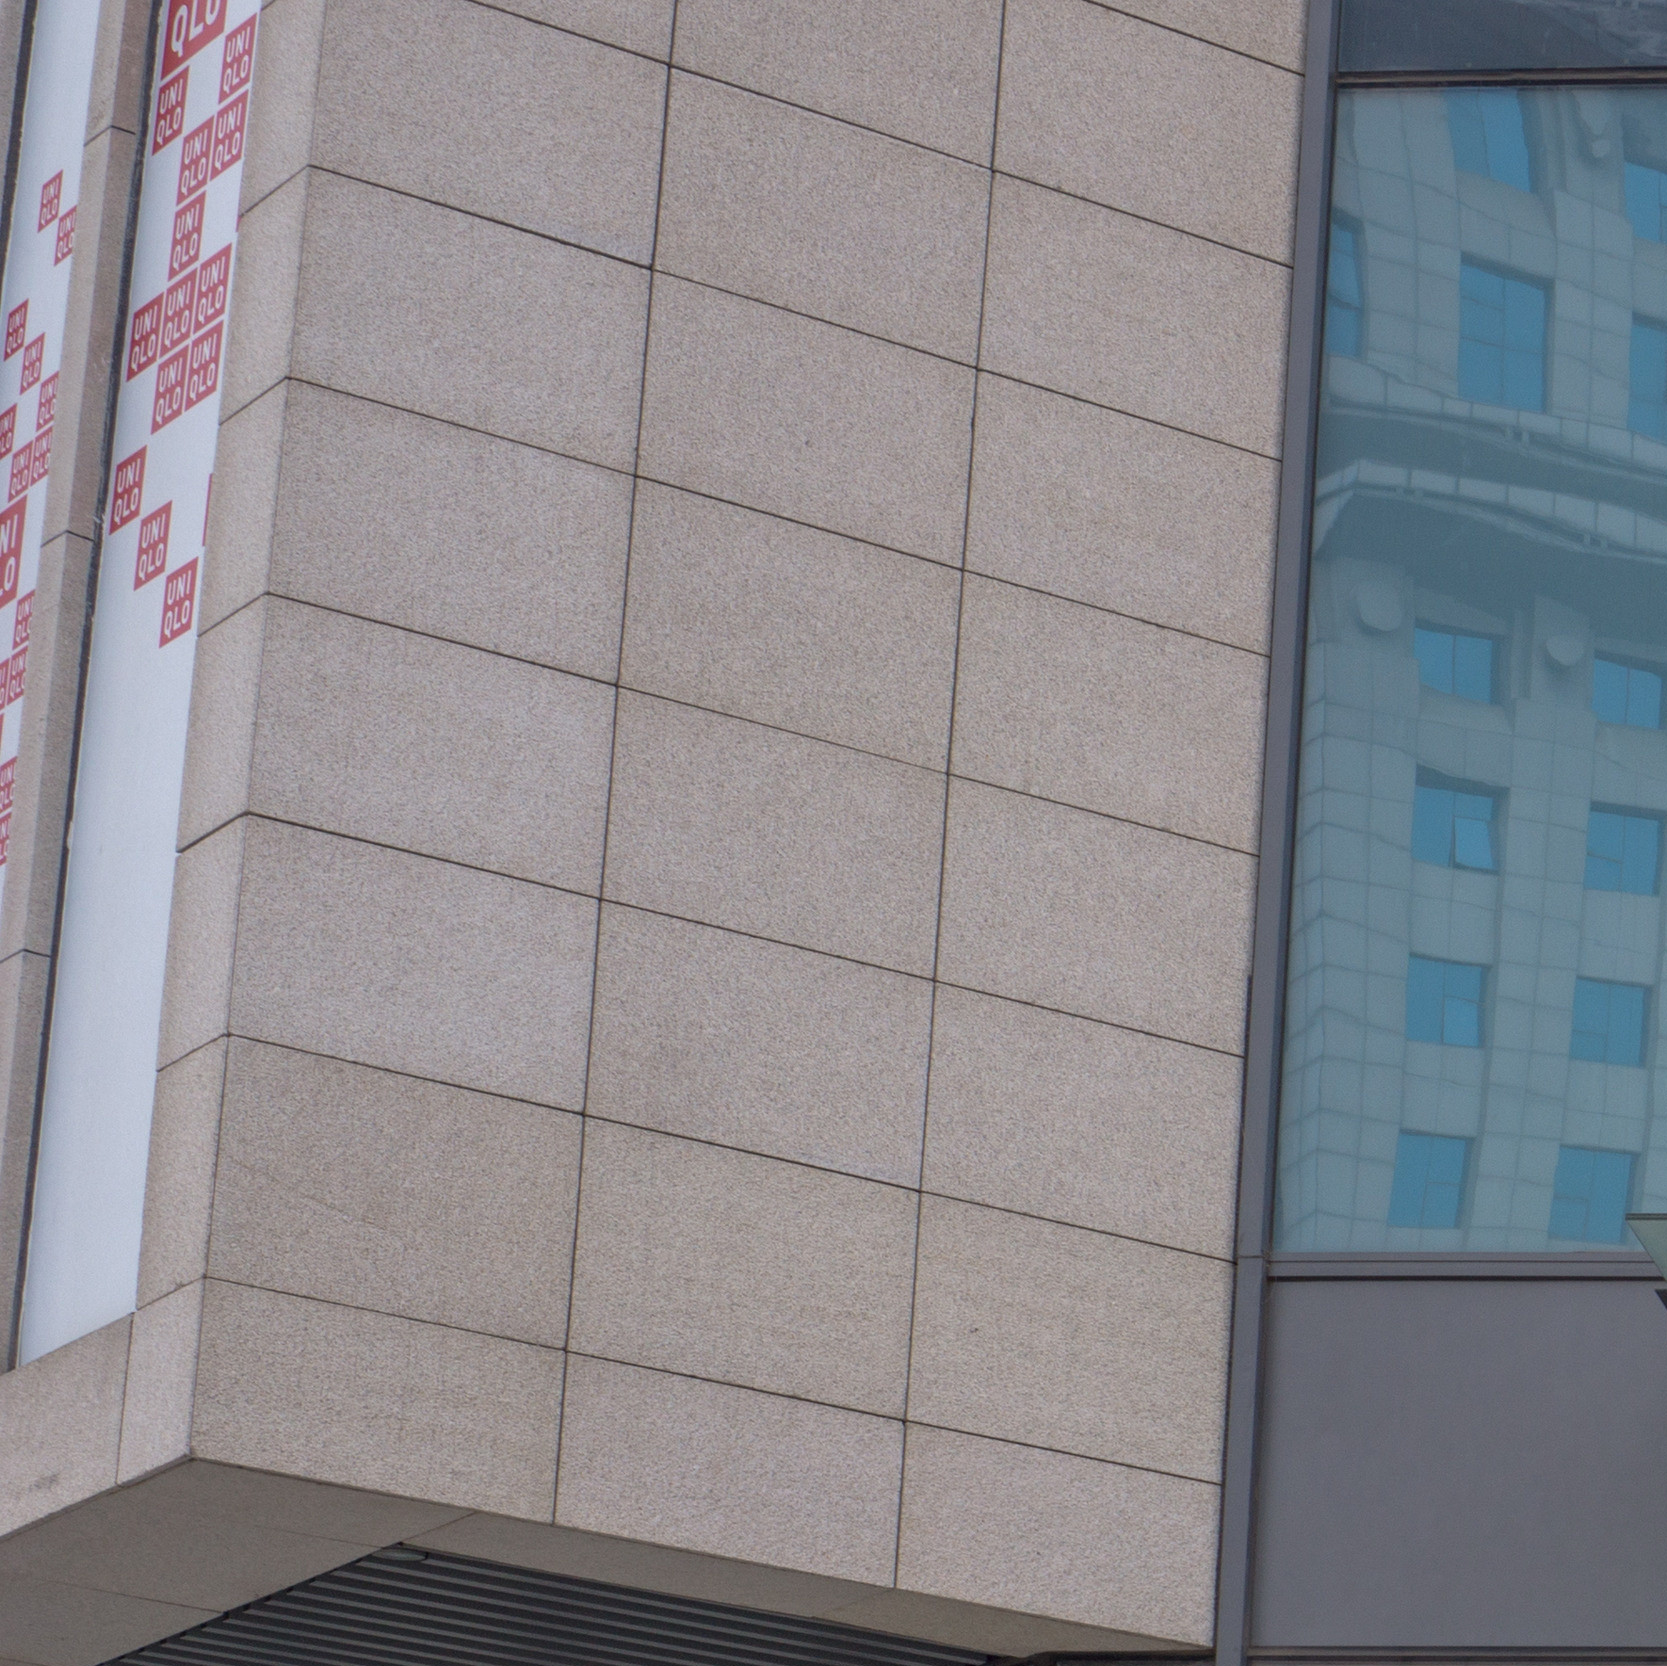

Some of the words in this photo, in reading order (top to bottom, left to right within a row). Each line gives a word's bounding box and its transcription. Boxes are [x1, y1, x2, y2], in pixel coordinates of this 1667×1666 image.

[226, 27, 250, 62] UNI
[223, 55, 249, 94] QLO
[160, 79, 183, 114] UNI
[156, 107, 182, 145] QLO
[217, 103, 242, 139] UNI
[184, 129, 208, 165] UNI
[215, 131, 240, 170] QLO
[181, 157, 206, 196] QLO
[176, 204, 200, 240] UNI
[172, 233, 198, 271] QLO
[201, 256, 225, 293] UNI
[167, 281, 191, 317] UNI
[198, 285, 224, 324] QLO
[134, 305, 158, 341] UNI
[164, 310, 189, 348] QLO
[131, 333, 156, 372] QLO
[192, 333, 217, 370] UNI
[159, 357, 182, 394] UNI
[190, 362, 216, 401] QLO
[156, 387, 181, 425] QLO
[117, 458, 141, 493] UNI
[114, 487, 139, 526] QLO
[141, 513, 166, 549] UNI
[138, 542, 165, 582] QLO
[167, 570, 192, 606] UNI
[164, 599, 190, 639] QLO
